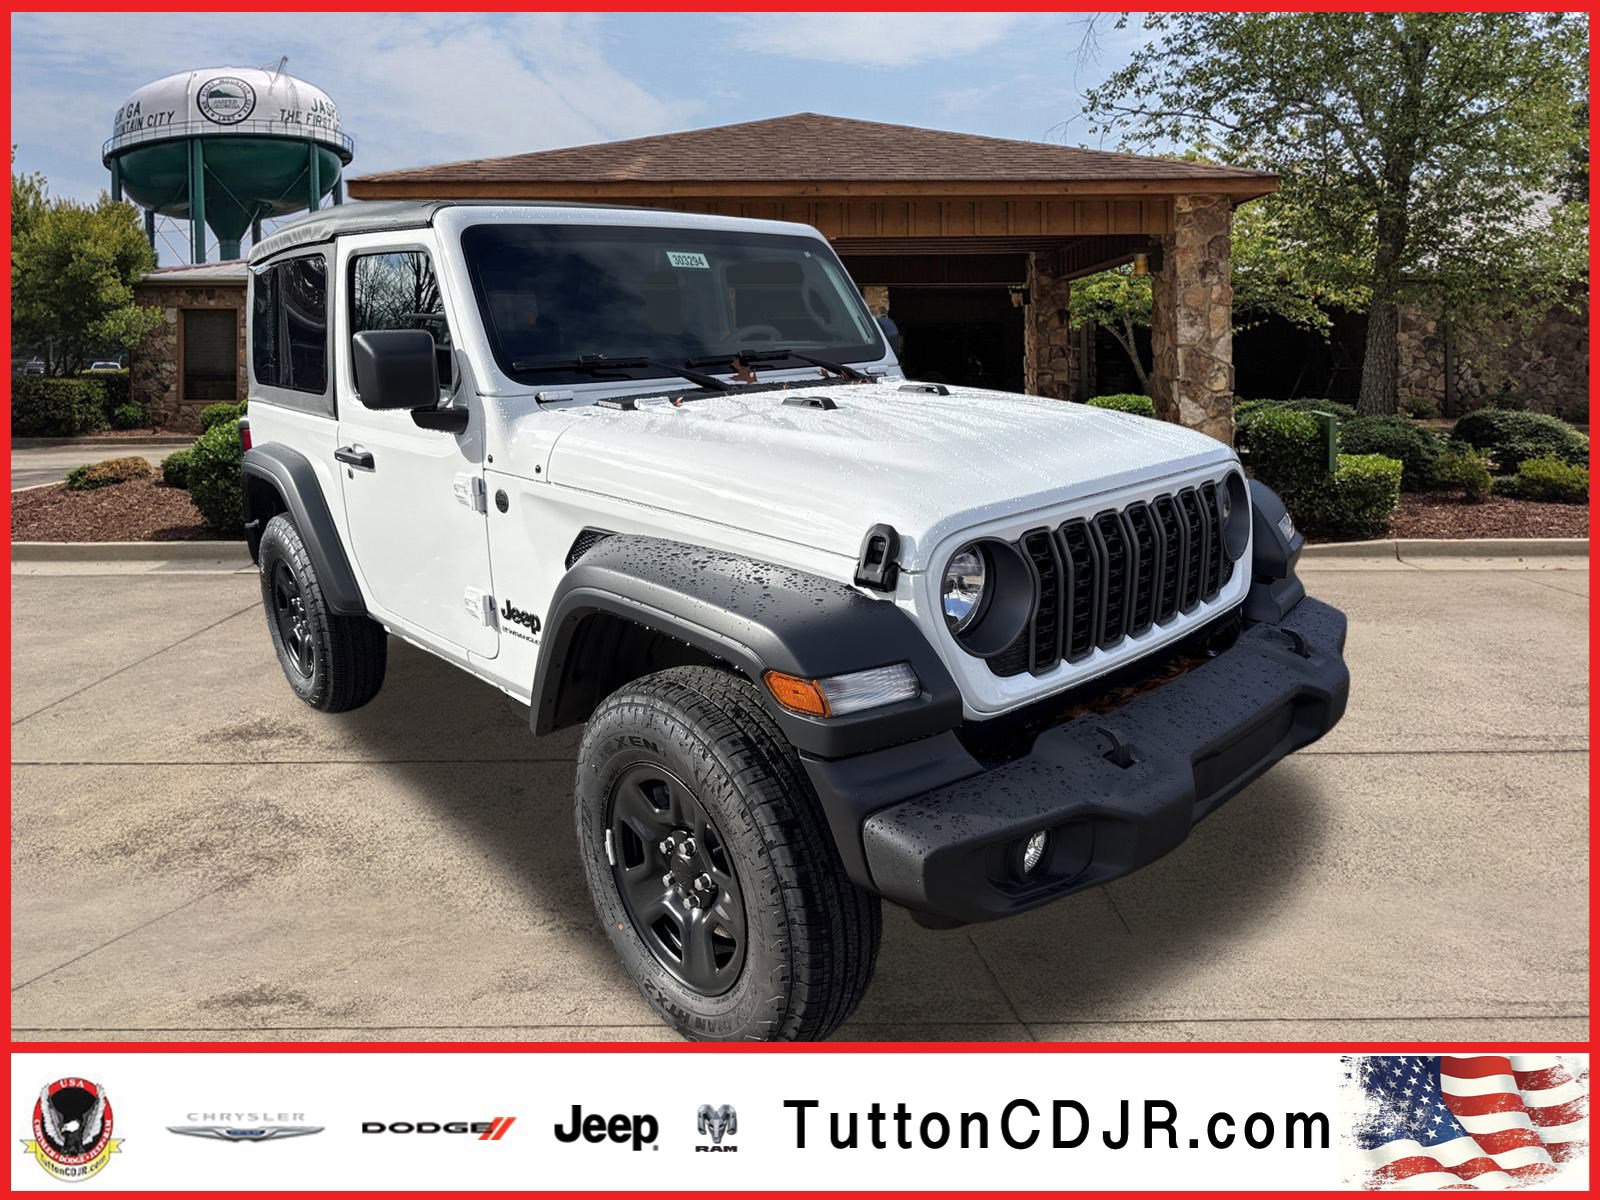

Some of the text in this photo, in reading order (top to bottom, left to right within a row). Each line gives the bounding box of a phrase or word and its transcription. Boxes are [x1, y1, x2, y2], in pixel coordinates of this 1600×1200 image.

[126, 101, 140, 119] GA
[147, 110, 175, 128] CITY
[280, 108, 302, 124] THE
[306, 112, 331, 130] FIRST
[672, 254, 705, 266] 303294
[500, 599, 542, 635] Jeep
